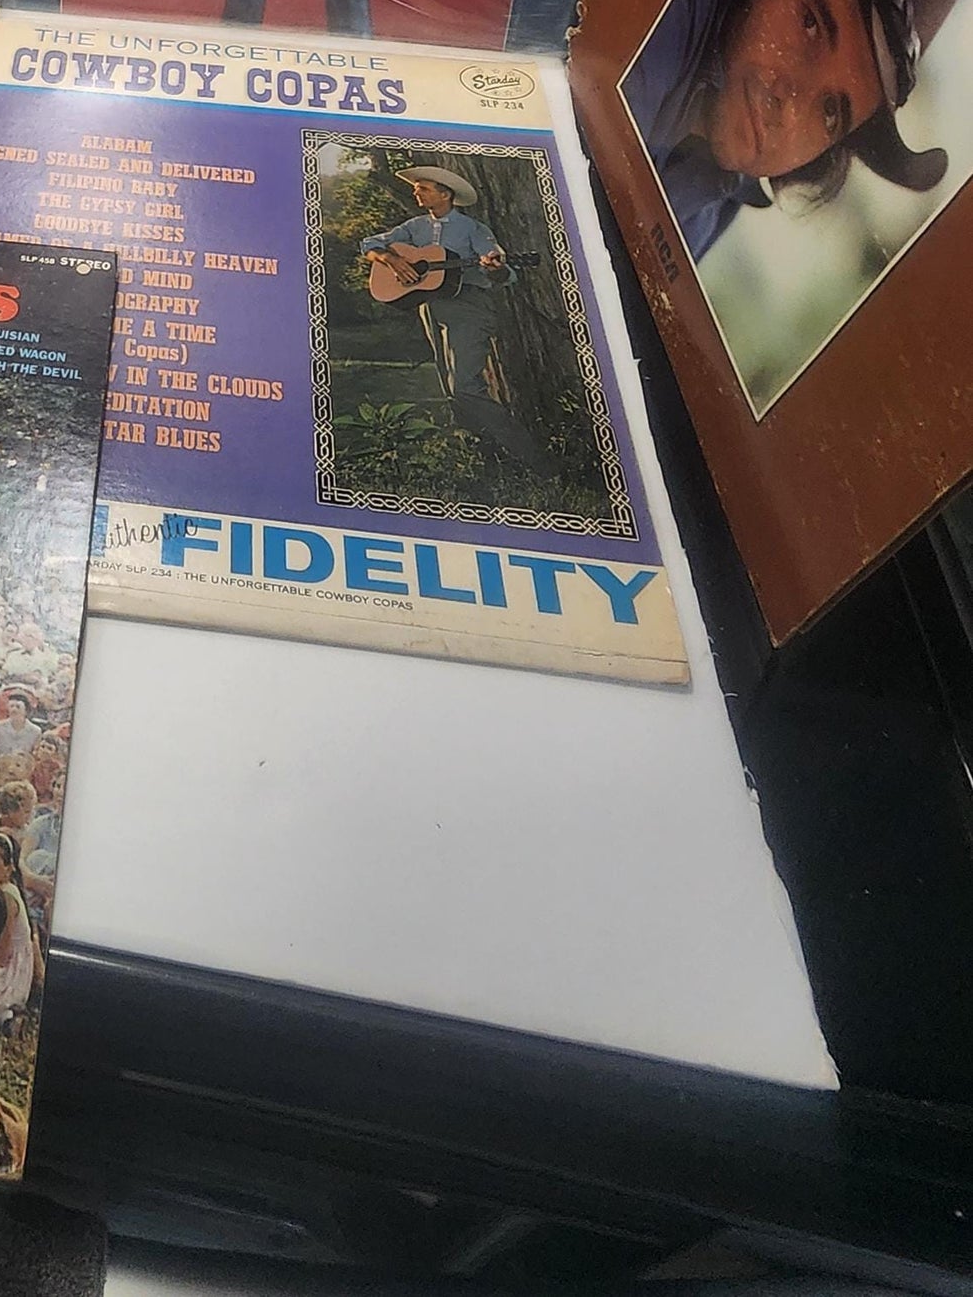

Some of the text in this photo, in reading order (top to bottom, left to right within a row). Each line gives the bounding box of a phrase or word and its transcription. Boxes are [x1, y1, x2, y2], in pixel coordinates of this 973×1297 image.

[34, 28, 390, 72] THE UNFORGETTABLE
[10, 47, 408, 115] COWBOY COPAS
[472, 74, 521, 92] Starday
[480, 99, 524, 110] SLP 234
[81, 134, 153, 154] ALABAM
[44, 151, 110, 171] SEALED
[116, 158, 153, 175] AND
[161, 162, 256, 185] DELIVERED
[20, 254, 112, 271] SLP 458 STEREO
[203, 252, 279, 276] HEAVEN
[18, 347, 68, 364] WAGON
[123, 337, 190, 366] Copas)
[10, 362, 39, 377] THE
[42, 365, 83, 381] DEVIL
[126, 364, 284, 402] IN THE CLOUDS
[155, 424, 222, 454] BLUES
[160, 511, 659, 625] FIDELITY
[184, 571, 414, 611] THE UNFORGETTABLE COWBOY COPAS
